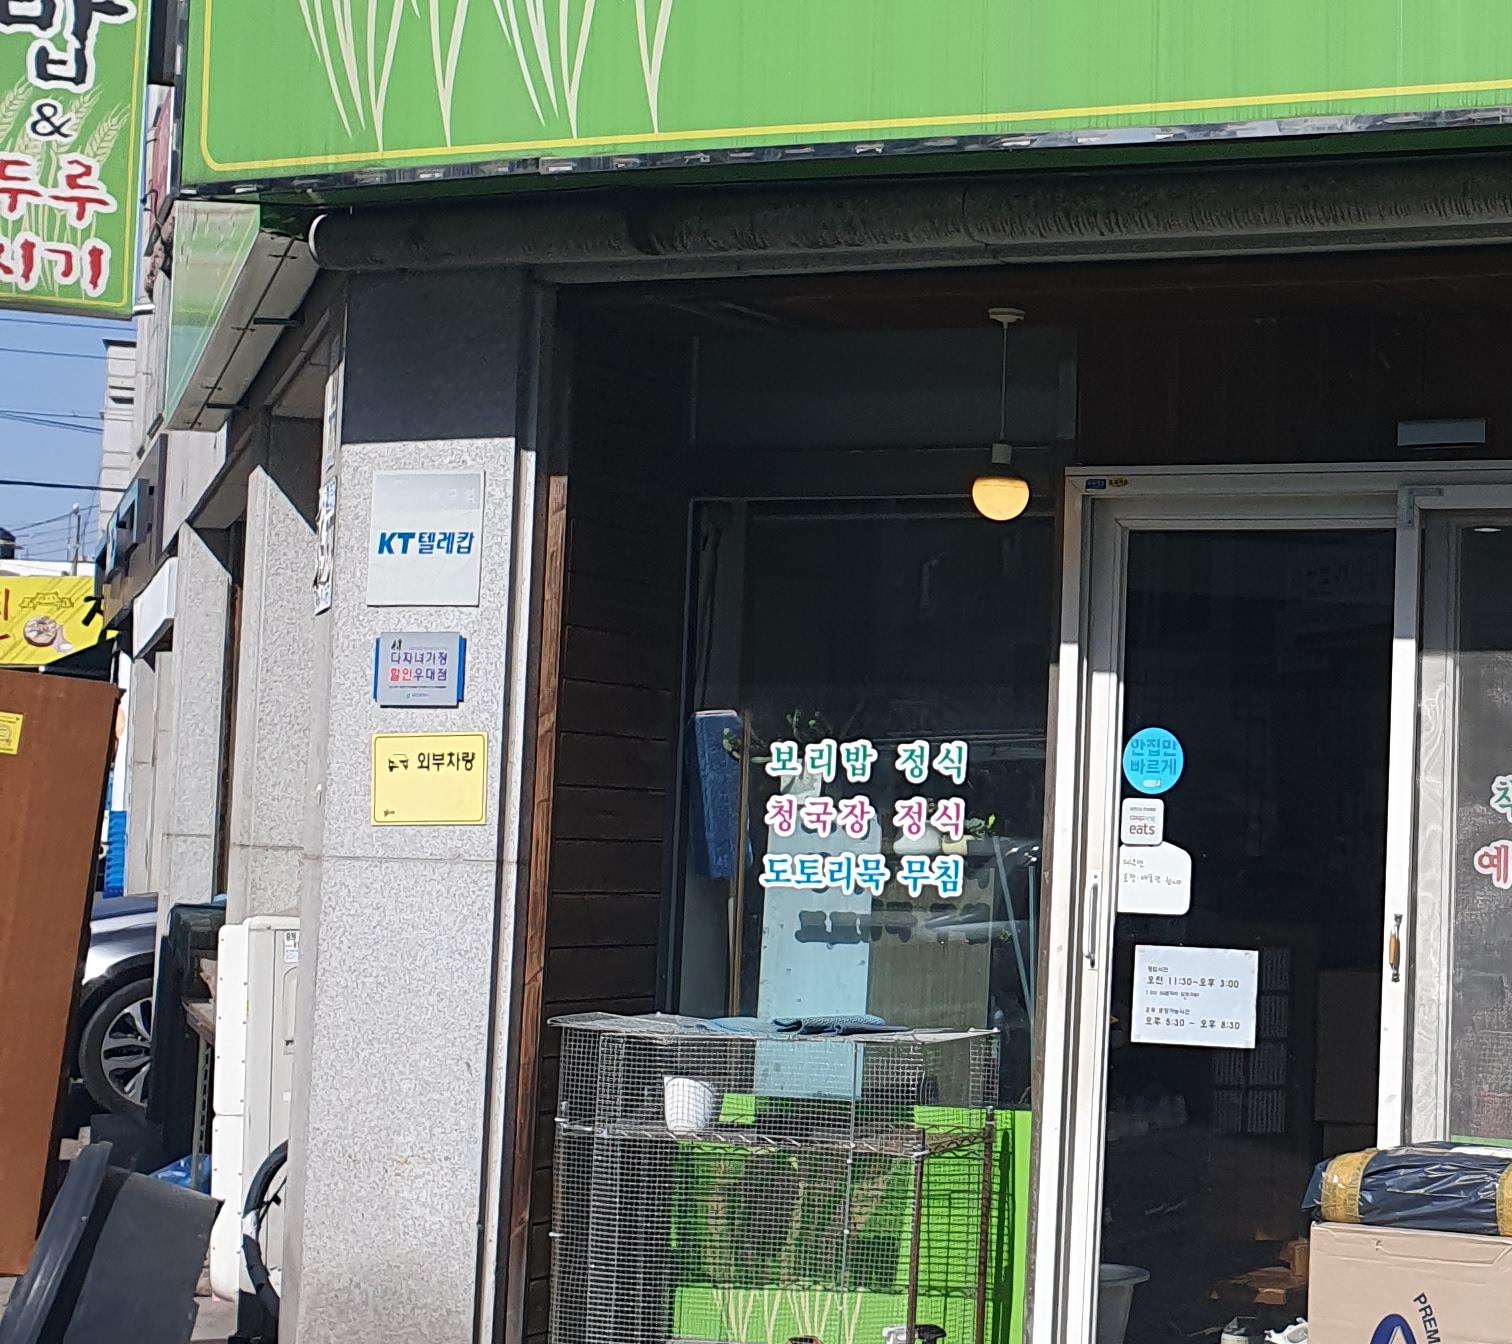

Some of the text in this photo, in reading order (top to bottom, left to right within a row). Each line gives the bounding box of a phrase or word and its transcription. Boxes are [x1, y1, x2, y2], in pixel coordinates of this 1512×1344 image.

[32, 102, 72, 138] &
[417, 751, 476, 772] 외부차량
[768, 743, 968, 781] 보리밥 정식
[767, 798, 965, 839] 청국장 정식
[1129, 823, 1156, 835] eats
[762, 856, 963, 895] 도토리묵 무침
